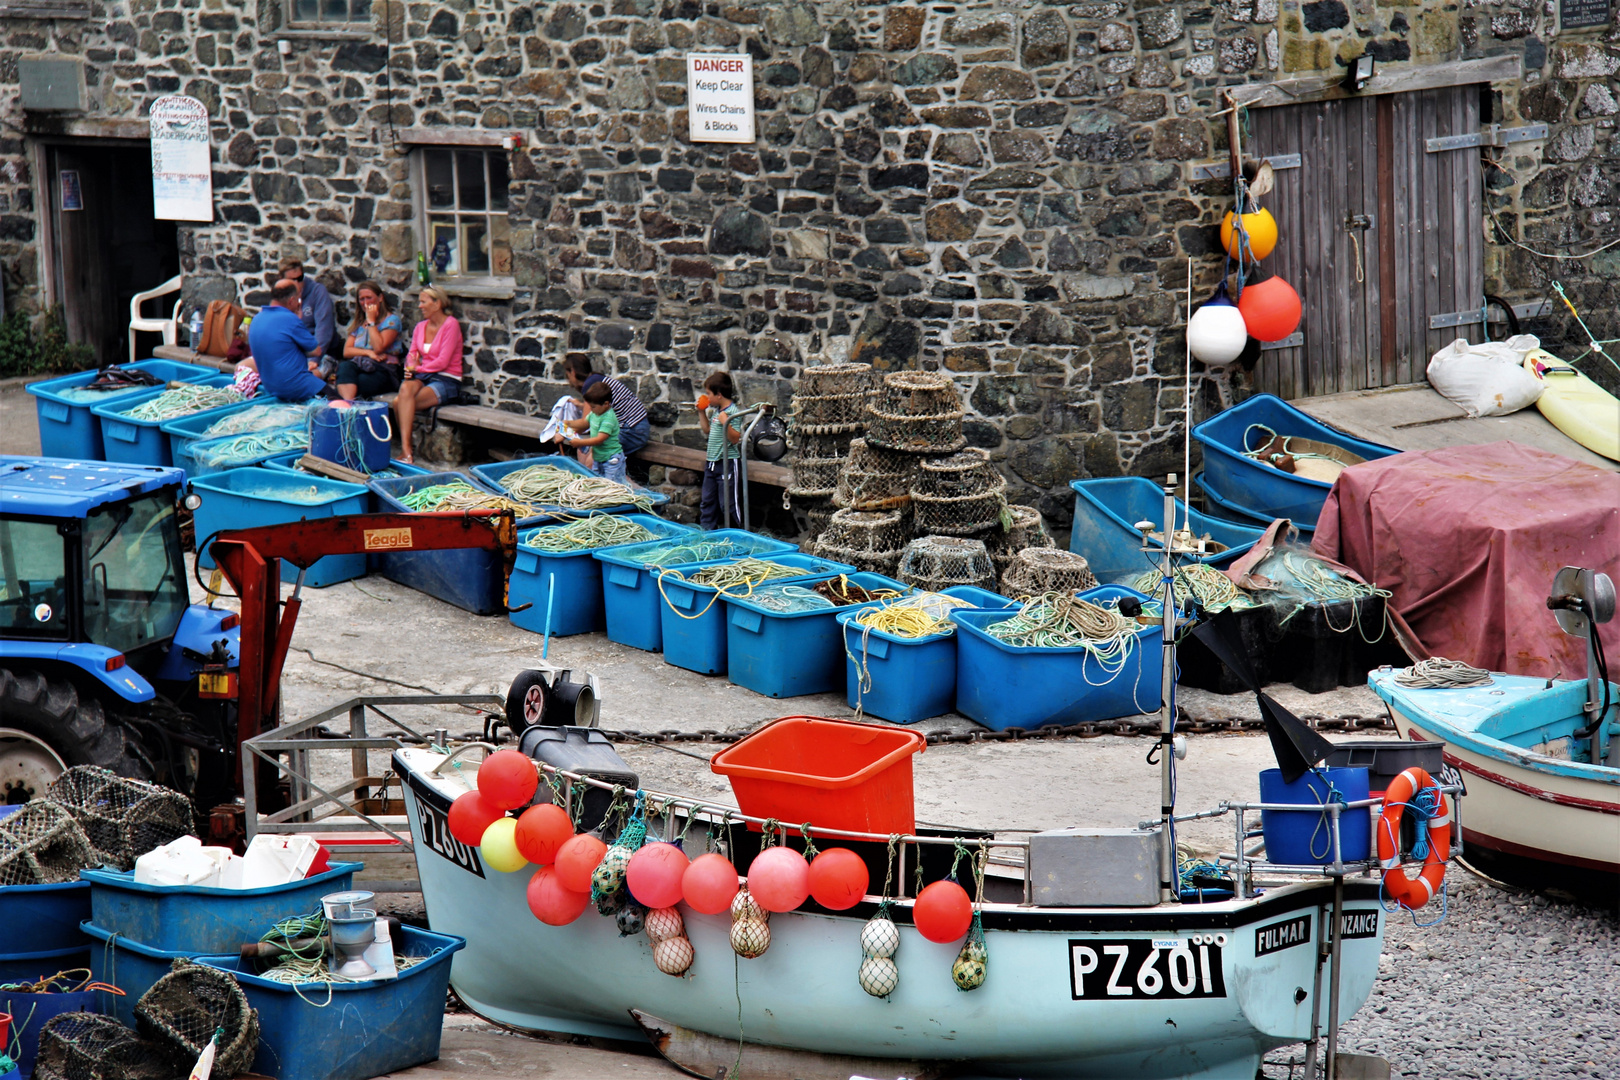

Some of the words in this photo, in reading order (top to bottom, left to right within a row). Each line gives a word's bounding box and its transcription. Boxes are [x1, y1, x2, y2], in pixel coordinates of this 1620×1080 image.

[694, 59, 744, 72] DANGER
[695, 79, 718, 92] Keep
[720, 80, 743, 91] Clear
[695, 103, 718, 113] Wires
[719, 104, 746, 115] Chains
[704, 121, 711, 130] &
[712, 121, 739, 131] Blocks
[152, 131, 208, 142] LEADERBOARD
[366, 531, 410, 547] Teagle
[1330, 913, 1377, 936] NZANCE
[1258, 920, 1305, 952] FULMAR
[1153, 940, 1179, 948] CYGNUS
[1072, 945, 1213, 997] PZ601
